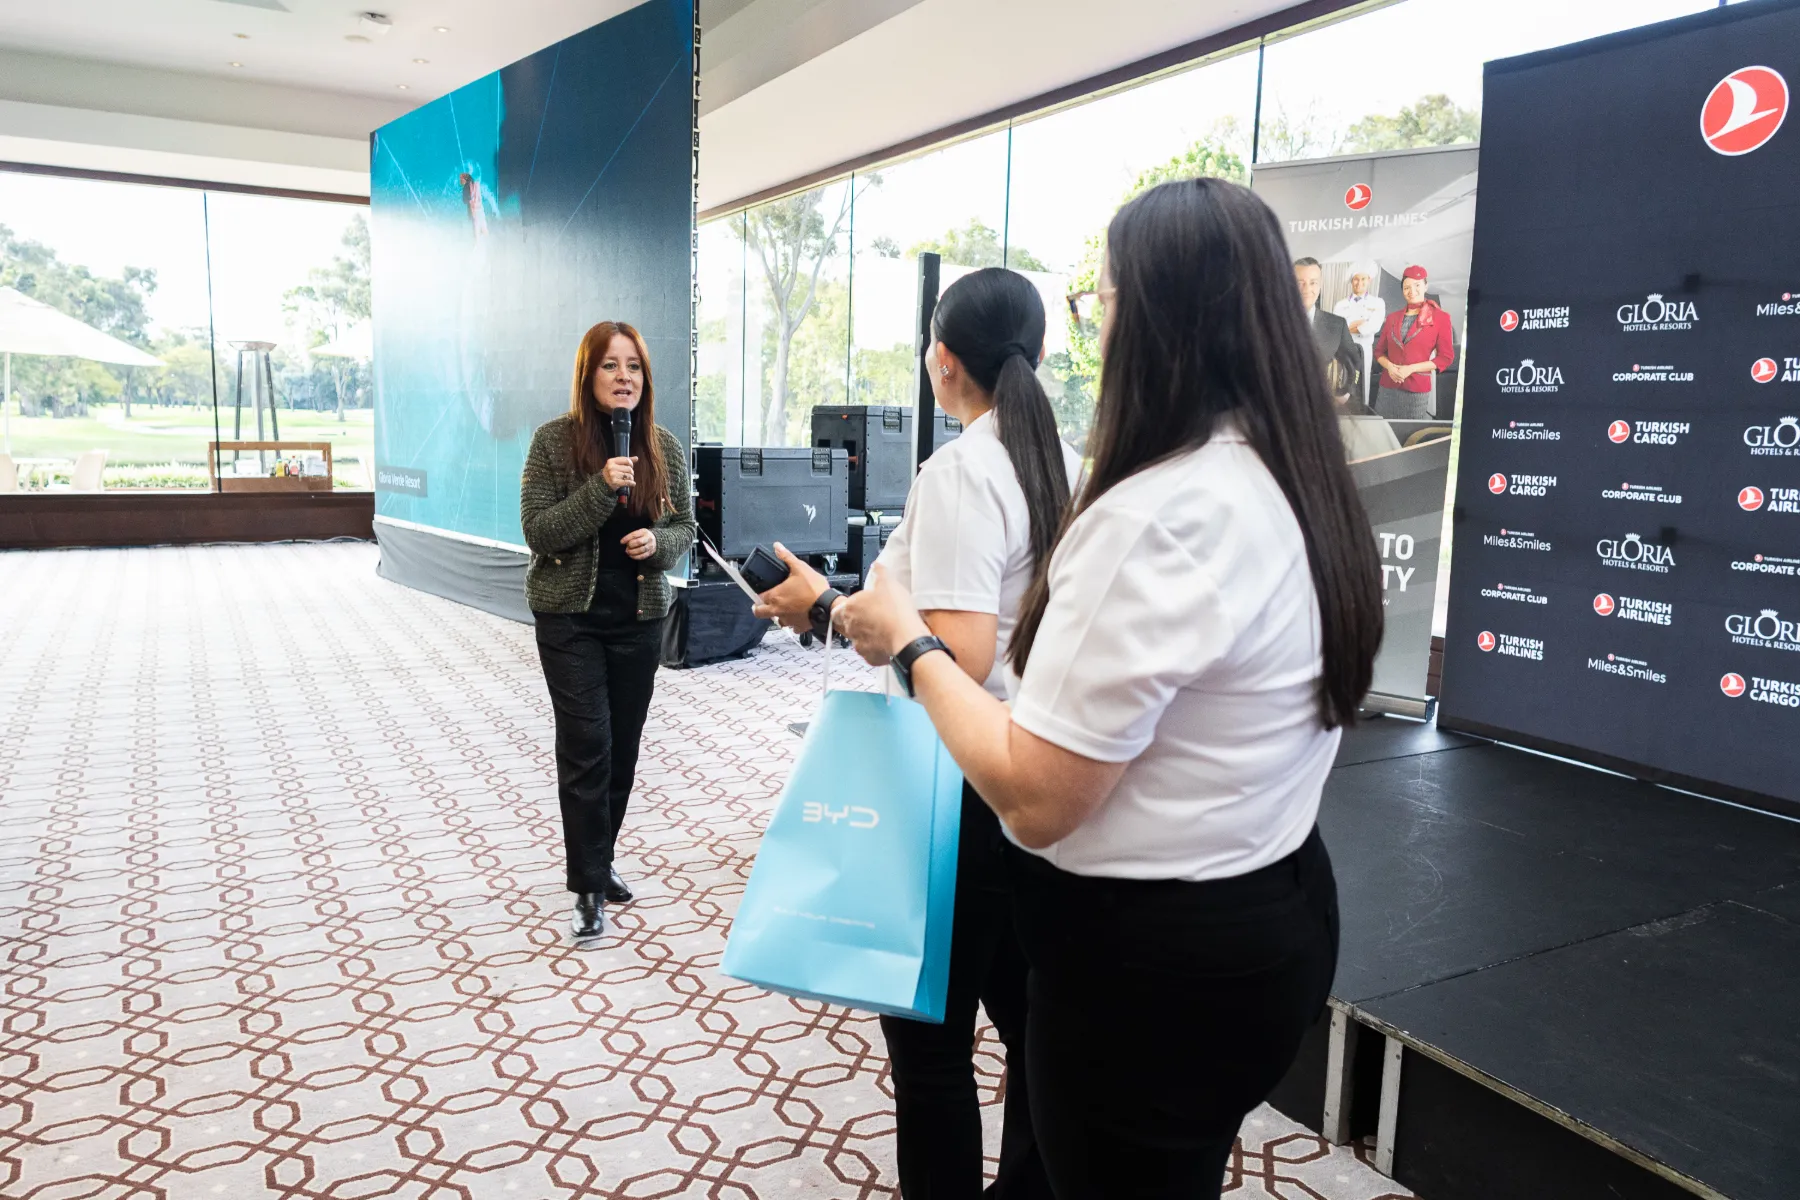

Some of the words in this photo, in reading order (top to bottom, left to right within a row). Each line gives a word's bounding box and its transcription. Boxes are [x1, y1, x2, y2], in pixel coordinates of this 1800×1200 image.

[1289, 217, 1353, 232] TURKISH
[1358, 212, 1428, 228] AIRLINES
[1523, 306, 1570, 319] TURKISH
[1617, 299, 1699, 324] GLORIA
[1522, 317, 1570, 330] AIRLINES
[1623, 324, 1650, 332] HOTELS
[1660, 322, 1692, 330] RESORTS
[1496, 364, 1565, 386] GLORIA
[1613, 372, 1666, 382] CORPORATE
[1669, 372, 1694, 381] CLUB
[1492, 428, 1560, 441] Miles&Smiles
[1635, 421, 1690, 434] TURKISH
[1633, 433, 1677, 445] CARGO
[1743, 424, 1800, 448] GLO
[1785, 448, 1792, 456] &
[1511, 474, 1557, 487] TURKISH
[1510, 485, 1546, 496] CARGO
[1602, 490, 1655, 502] CORPORATE
[1657, 494, 1682, 504] CLUB
[1770, 488, 1800, 500] TUR
[1380, 532, 1414, 560] TO
[1484, 535, 1551, 551] Miles&Smiles
[1596, 538, 1676, 566] GLORIA
[1602, 559, 1629, 569] HOTELS
[1637, 563, 1669, 573] RESORTS
[1731, 561, 1794, 575] CORPORATE
[1381, 564, 1415, 592] TY
[1481, 589, 1525, 601] CORPORATE
[1527, 594, 1548, 604] CLUB
[1619, 596, 1672, 614] TURKISH
[1618, 608, 1671, 625] AIRLINES
[1500, 634, 1543, 650] TURKISH
[1732, 636, 1763, 647] HOTELS
[1765, 640, 1772, 648] &
[1498, 645, 1543, 660] AIRLINES
[1588, 658, 1666, 684] Miles&Smiles
[1750, 689, 1800, 707] CARGO
[802, 802, 879, 829] BYD
